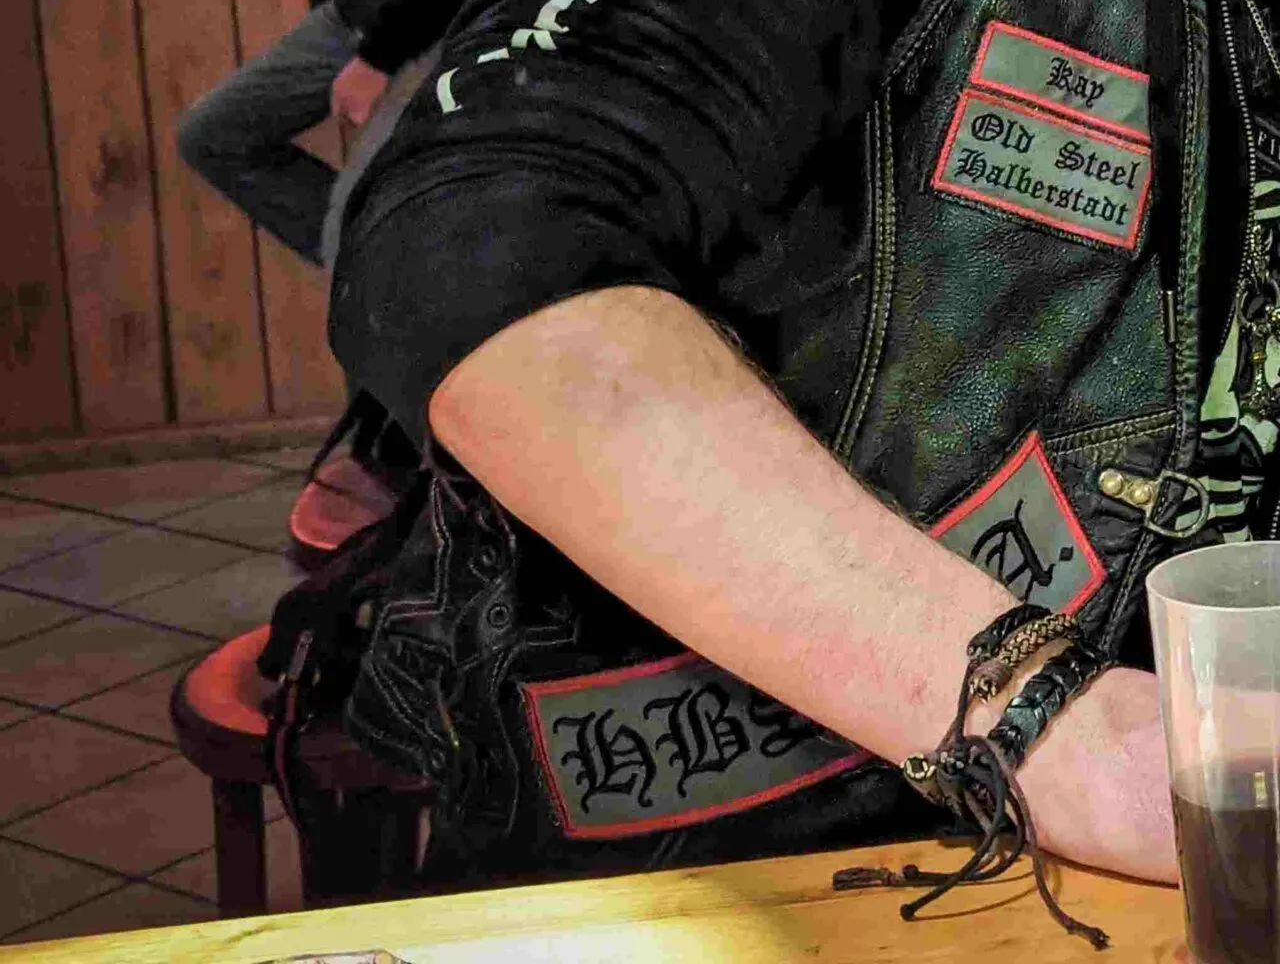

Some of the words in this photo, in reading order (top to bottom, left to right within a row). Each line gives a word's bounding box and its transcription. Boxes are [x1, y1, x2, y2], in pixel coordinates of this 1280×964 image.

[957, 148, 1130, 225] Halberstadt
[971, 113, 1036, 154] Old
[1055, 140, 1142, 190] Steel
